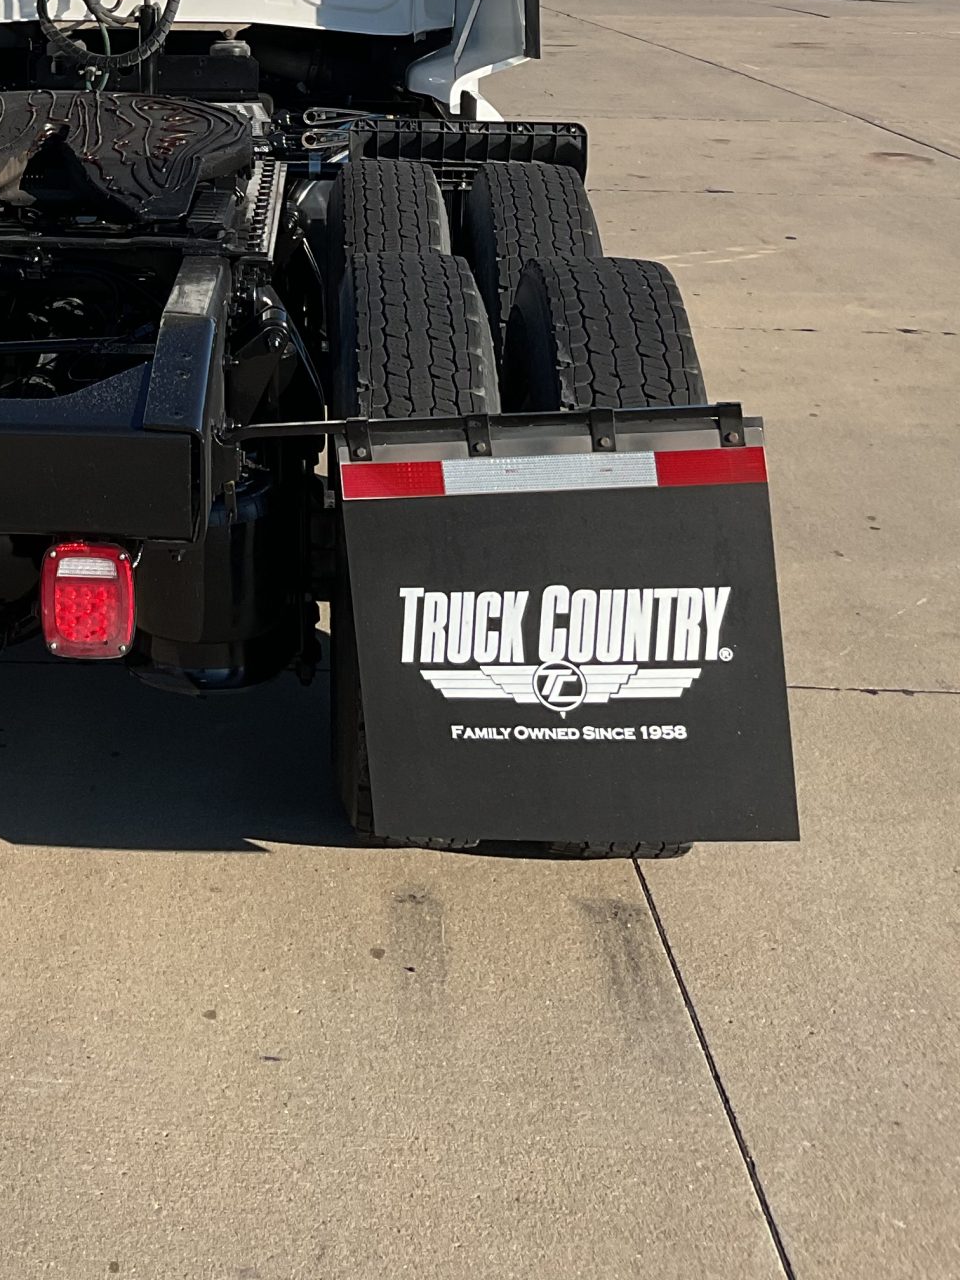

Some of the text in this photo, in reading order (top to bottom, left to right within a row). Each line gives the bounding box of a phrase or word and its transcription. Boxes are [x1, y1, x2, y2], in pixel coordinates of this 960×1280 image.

[399, 587, 530, 664] TRUCK
[451, 724, 688, 740] FAMILY OWNED SINCE 1958
